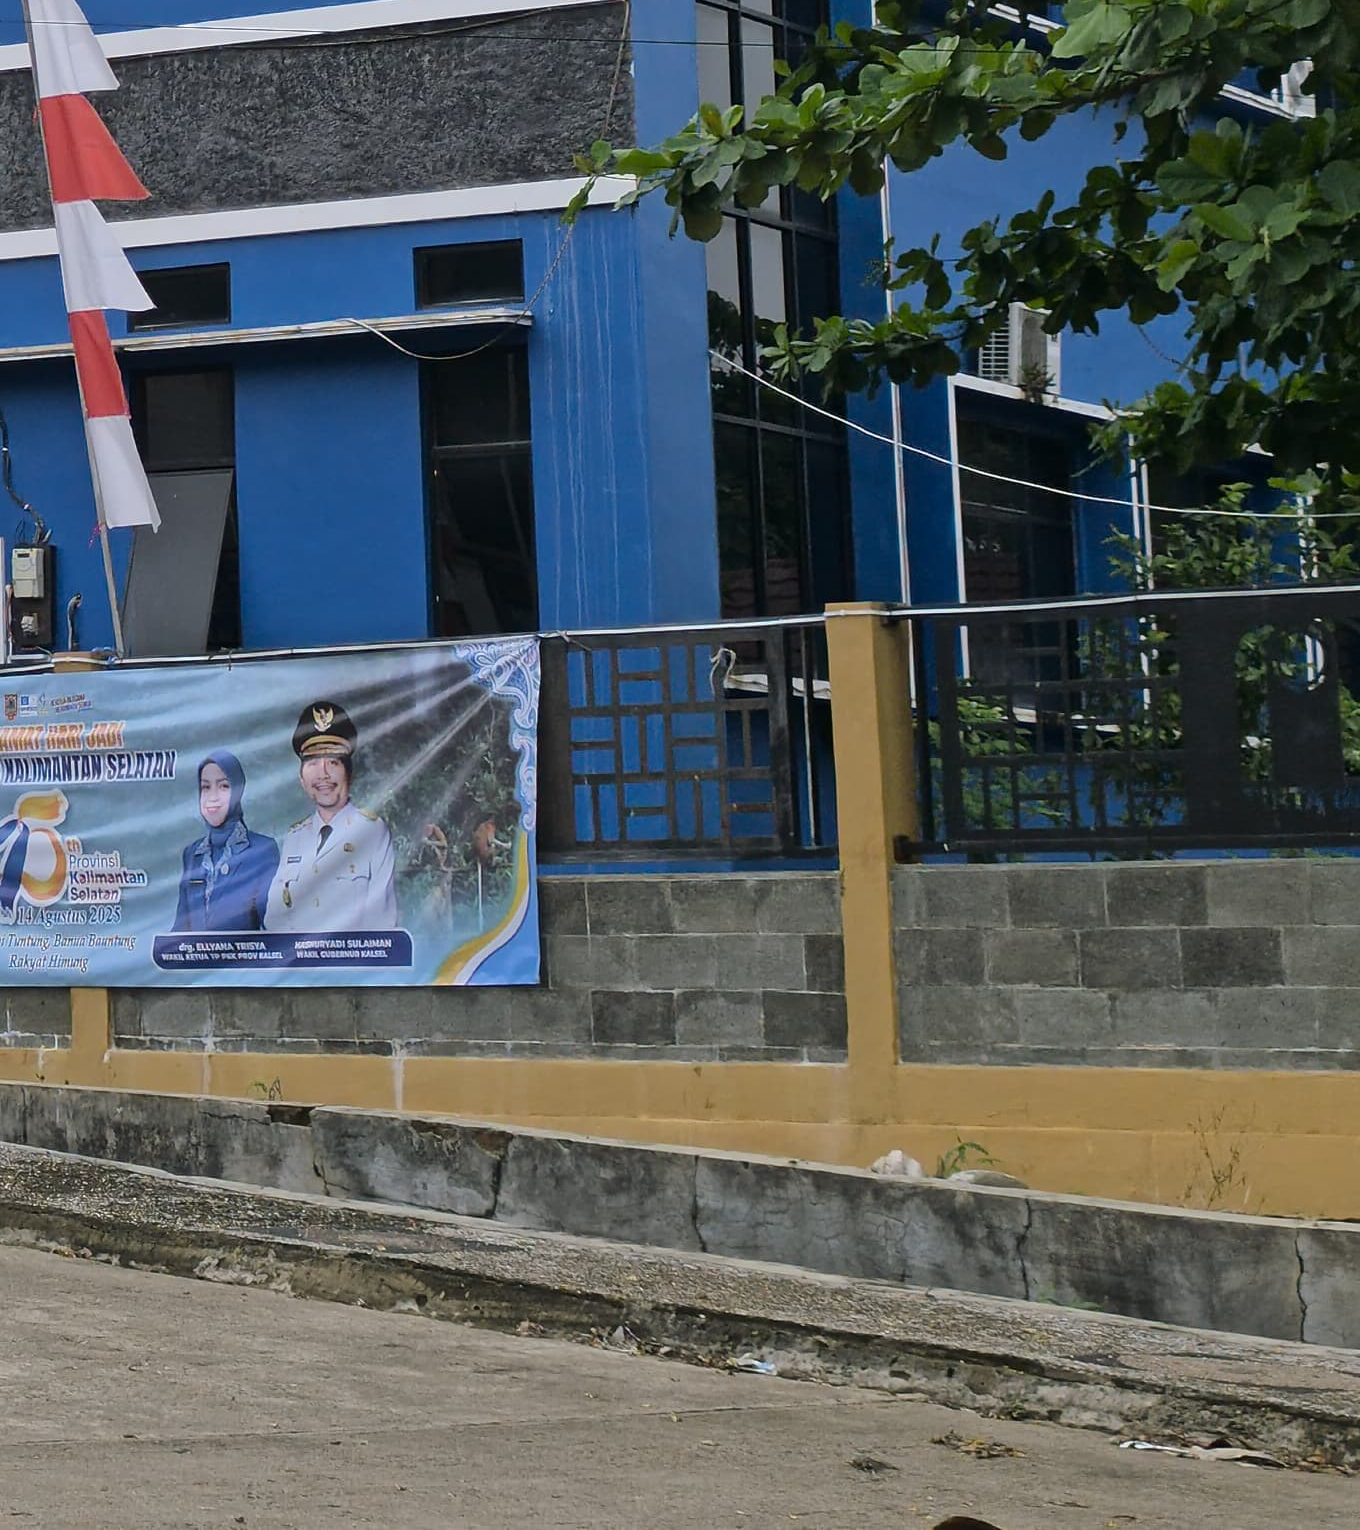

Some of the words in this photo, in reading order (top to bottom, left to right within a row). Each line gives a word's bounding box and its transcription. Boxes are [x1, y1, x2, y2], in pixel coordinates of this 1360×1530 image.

[46, 723, 84, 750] HARI
[86, 721, 125, 750] JADI
[3, 754, 102, 783] KALIMANTAN
[106, 750, 176, 780] SELATAN
[69, 852, 120, 869] Provinsi
[69, 870, 146, 885] Kalimantan
[70, 887, 119, 902] Selatan
[17, 906, 33, 922] 14
[35, 905, 88, 927] Agustus
[91, 906, 121, 922] 2025
[52, 933, 88, 948] Banua
[88, 934, 136, 951] Bauntung
[178, 942, 195, 954] drg.
[196, 942, 234, 952] ELLYANA
[236, 941, 266, 951] TRISYA
[294, 939, 346, 950] HASNURYADI
[347, 938, 392, 949] SULAIMAN
[296, 950, 320, 959] WAKIL
[361, 949, 388, 958] KALSEL
[8, 954, 49, 971] Rakyat
[49, 955, 89, 972] Himung
